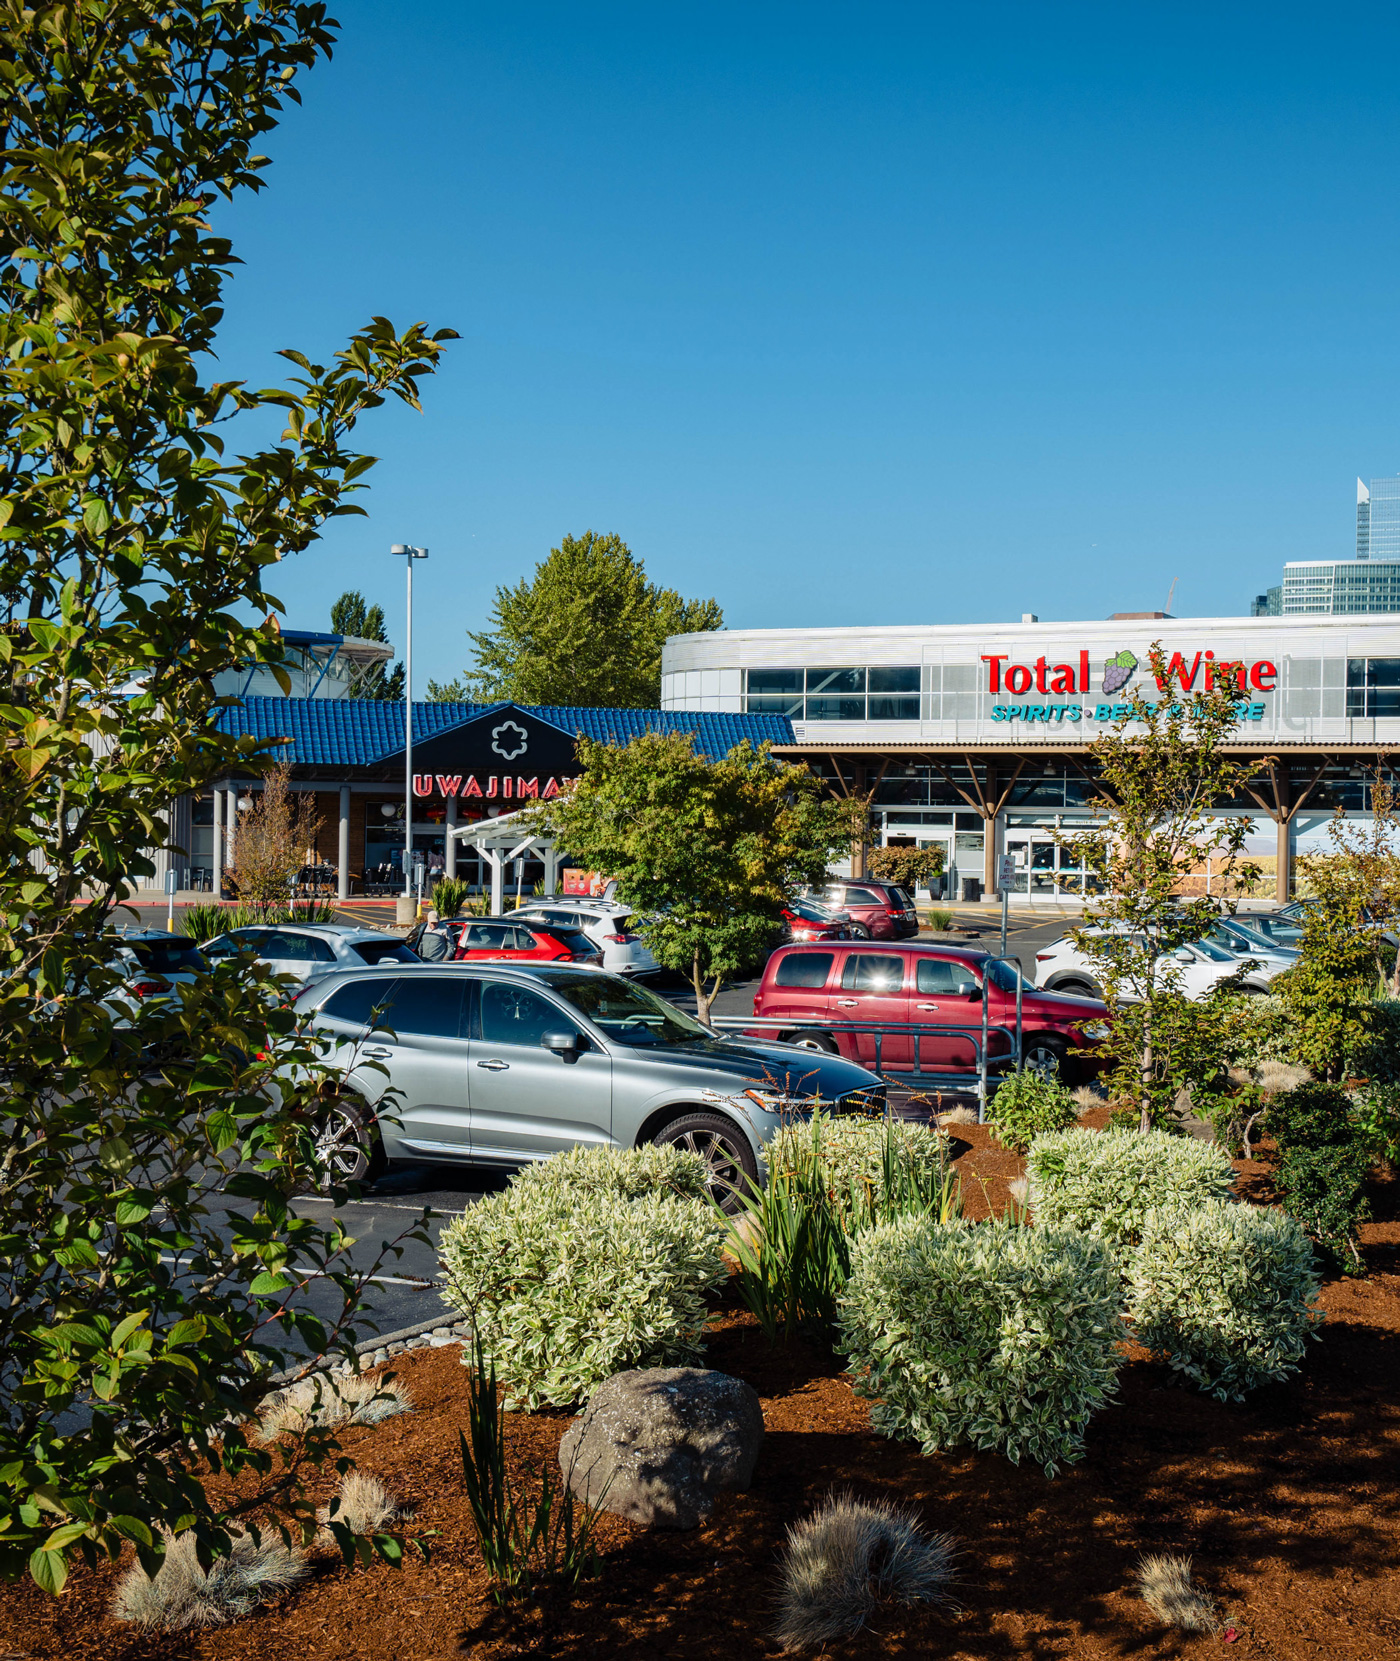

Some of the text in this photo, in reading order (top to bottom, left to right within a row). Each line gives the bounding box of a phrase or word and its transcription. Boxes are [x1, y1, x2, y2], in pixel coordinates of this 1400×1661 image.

[981, 649, 1277, 694] Total Wine
[991, 704, 1082, 721] SPIRITS
